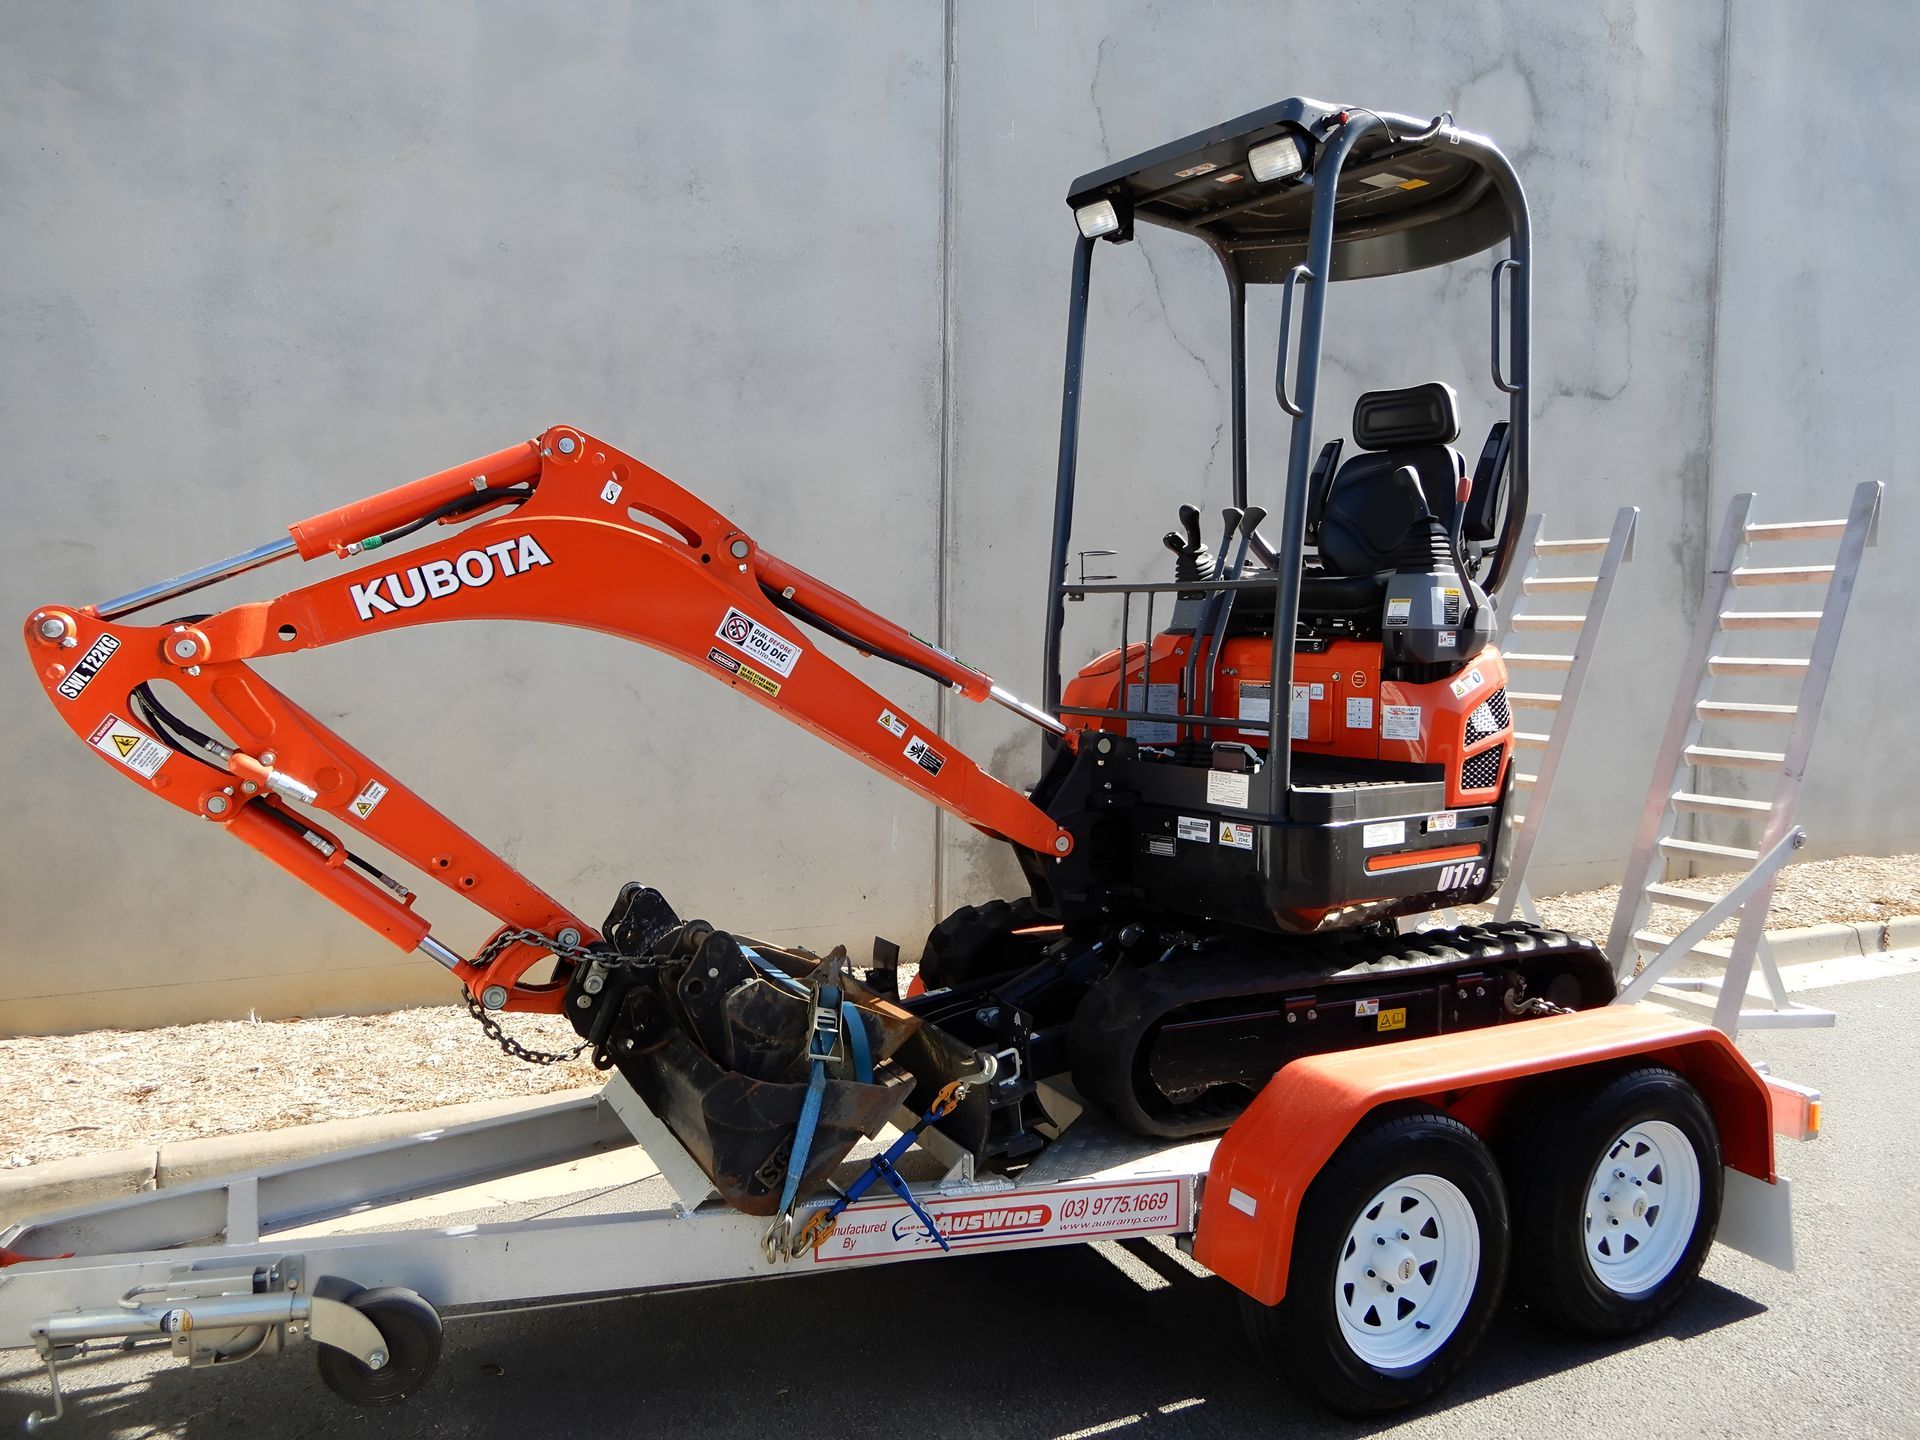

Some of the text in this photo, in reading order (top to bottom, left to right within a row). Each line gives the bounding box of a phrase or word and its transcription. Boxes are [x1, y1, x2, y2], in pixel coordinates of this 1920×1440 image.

[349, 534, 553, 621] KUBOTA
[749, 634, 789, 663] YOU DIG
[754, 629, 792, 654] DIAL BEFORE
[60, 635, 120, 698] SWL 122KG
[1059, 1191, 1169, 1222] (03) 9775.1669
[831, 1220, 888, 1237] nufactured
[1059, 1214, 1168, 1231] www.ausramp.com
[842, 1237, 857, 1251] By
